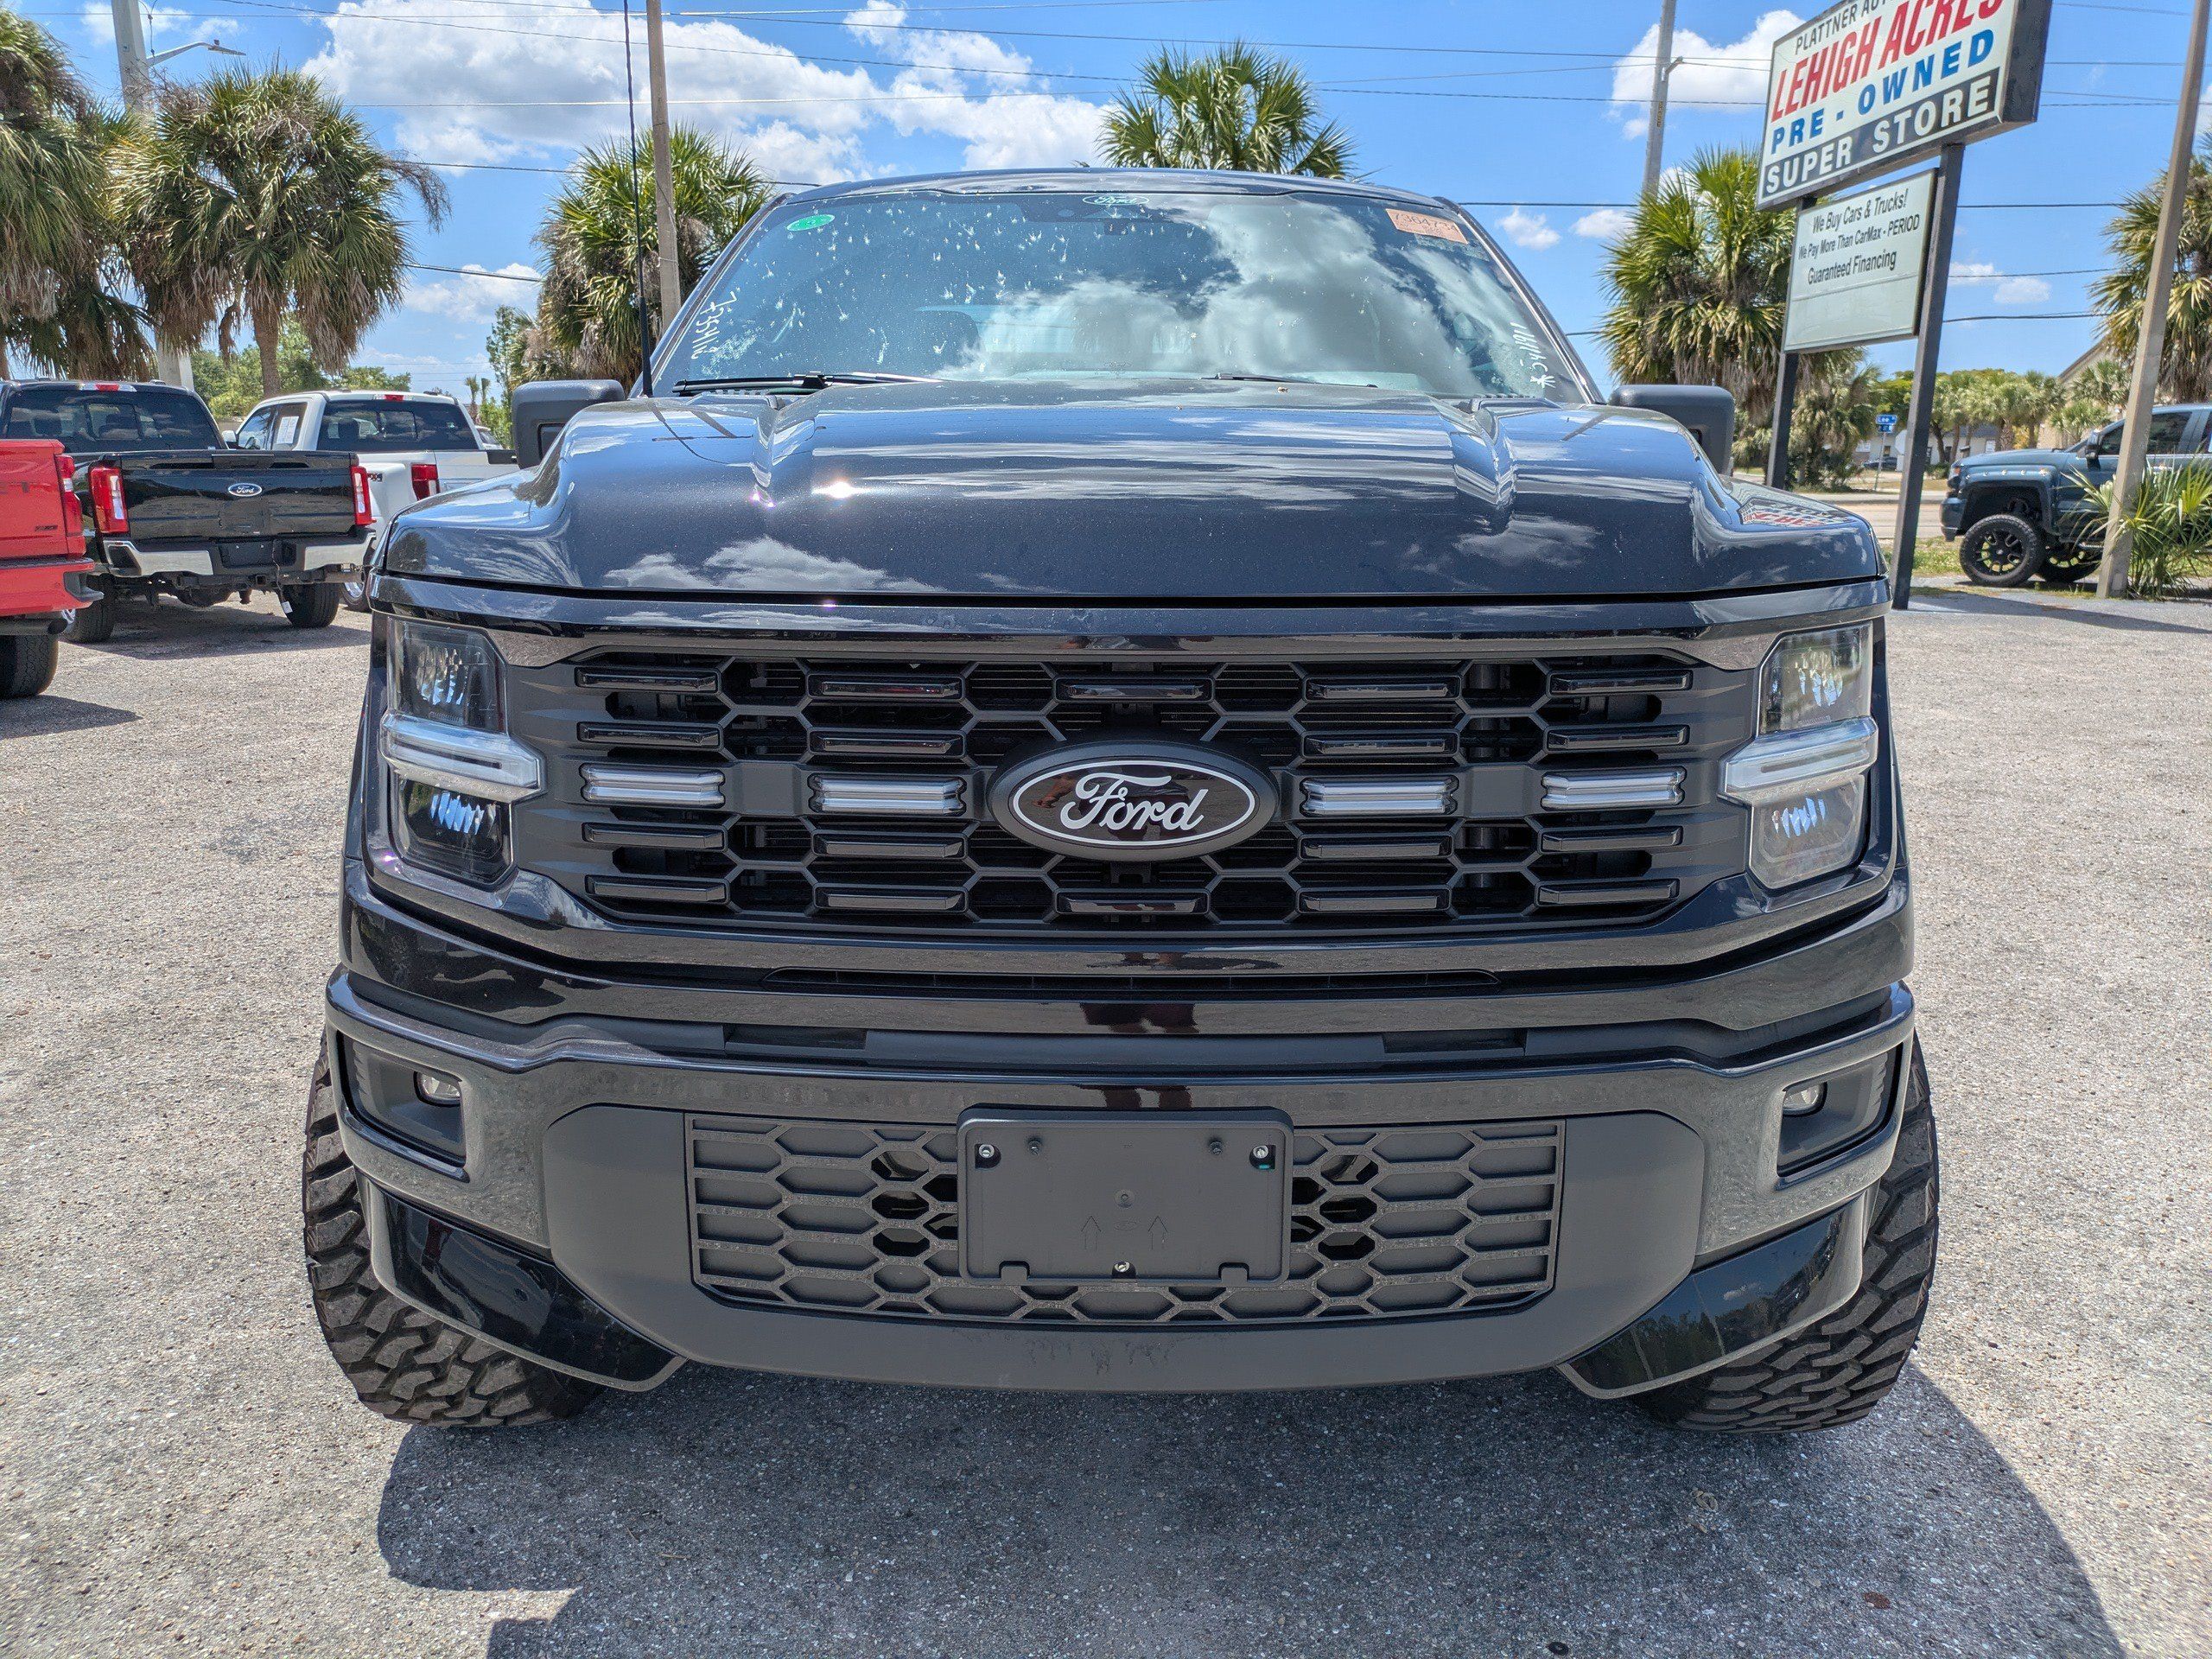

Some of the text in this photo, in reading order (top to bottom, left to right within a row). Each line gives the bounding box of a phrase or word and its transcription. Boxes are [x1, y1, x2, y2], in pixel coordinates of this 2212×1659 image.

[1796, 3, 1858, 55] PLATTNER
[1771, 16, 1882, 124] LEHIGH
[1771, 108, 1825, 156] PRE
[1858, 29, 1995, 116] OWNED
[1766, 75, 1992, 194] SUPER STORE
[1798, 245, 1808, 261] We
[1807, 244, 1819, 260] Pay
[1820, 238, 1837, 256] More
[1837, 233, 1853, 251] Than
[1854, 226, 1882, 245] CarMax
[1887, 213, 1921, 238] PERIOD
[1813, 188, 1910, 234] We Buy Cars & Trucks!
[1808, 249, 1897, 286] Guaranteed Financing
[236, 485, 255, 493] Ford
[1059, 772, 1210, 831] Ford
